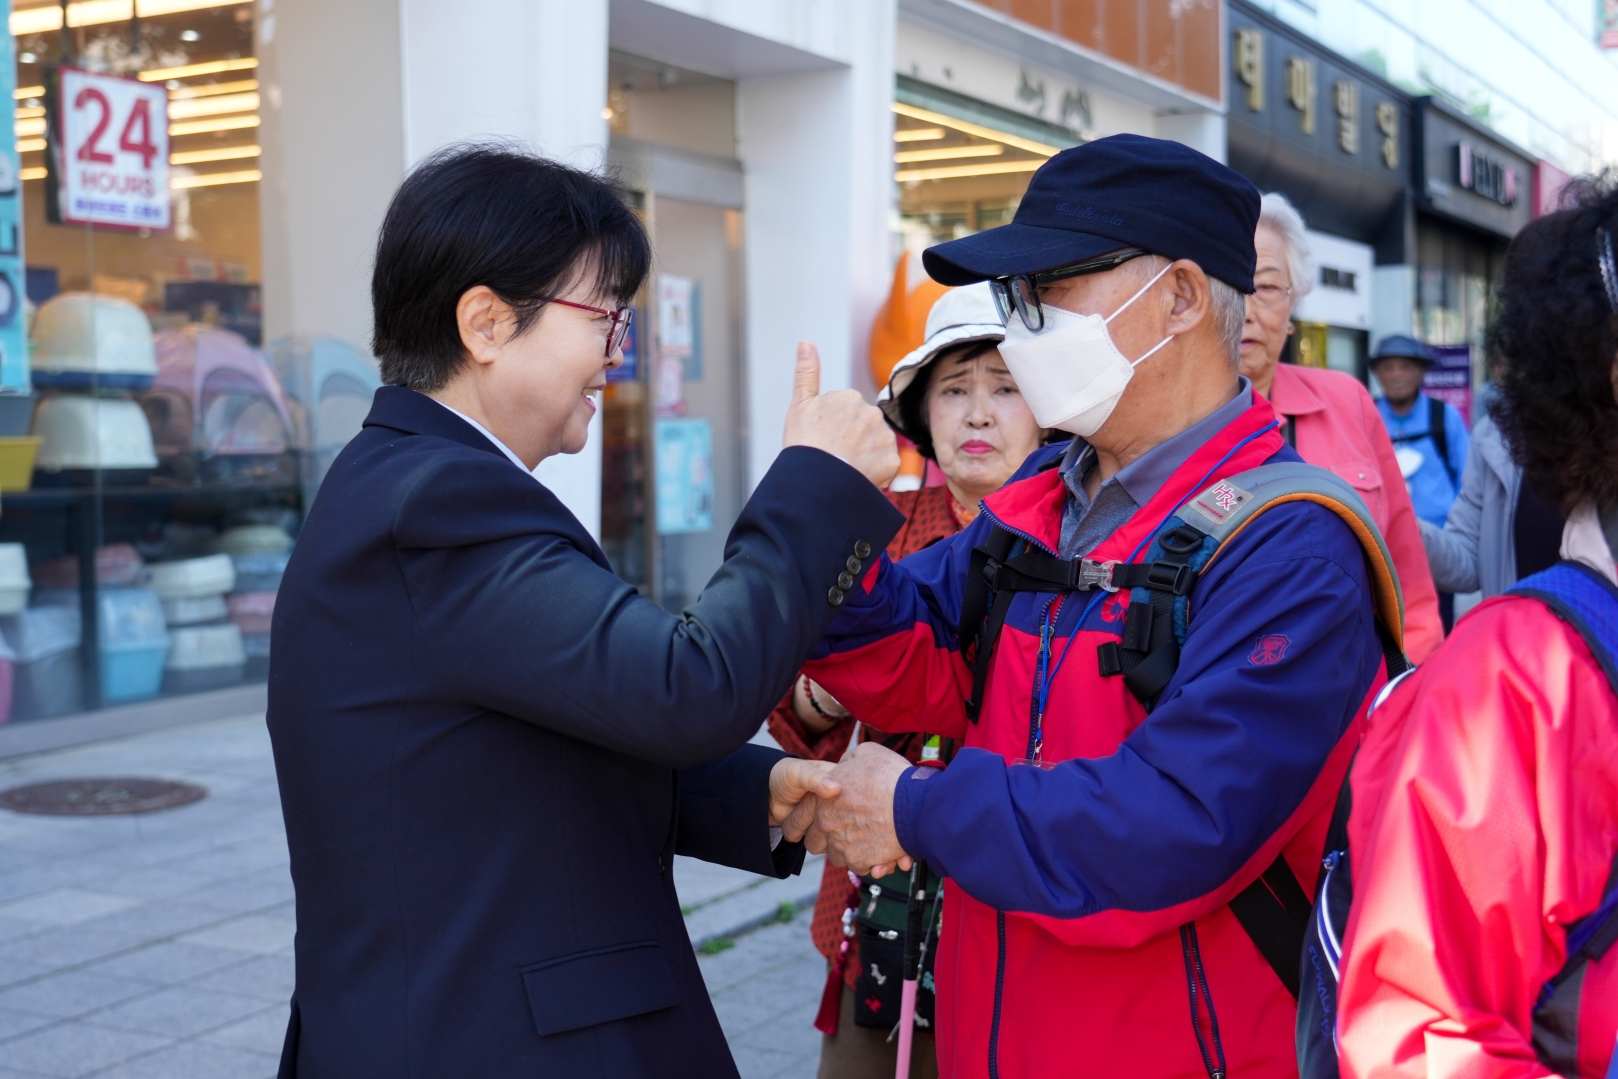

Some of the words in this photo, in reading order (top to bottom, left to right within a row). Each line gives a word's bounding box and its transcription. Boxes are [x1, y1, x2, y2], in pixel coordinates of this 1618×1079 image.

[75, 88, 157, 170] 24
[81, 171, 156, 197] HOURS
[1056, 202, 1124, 227] California
